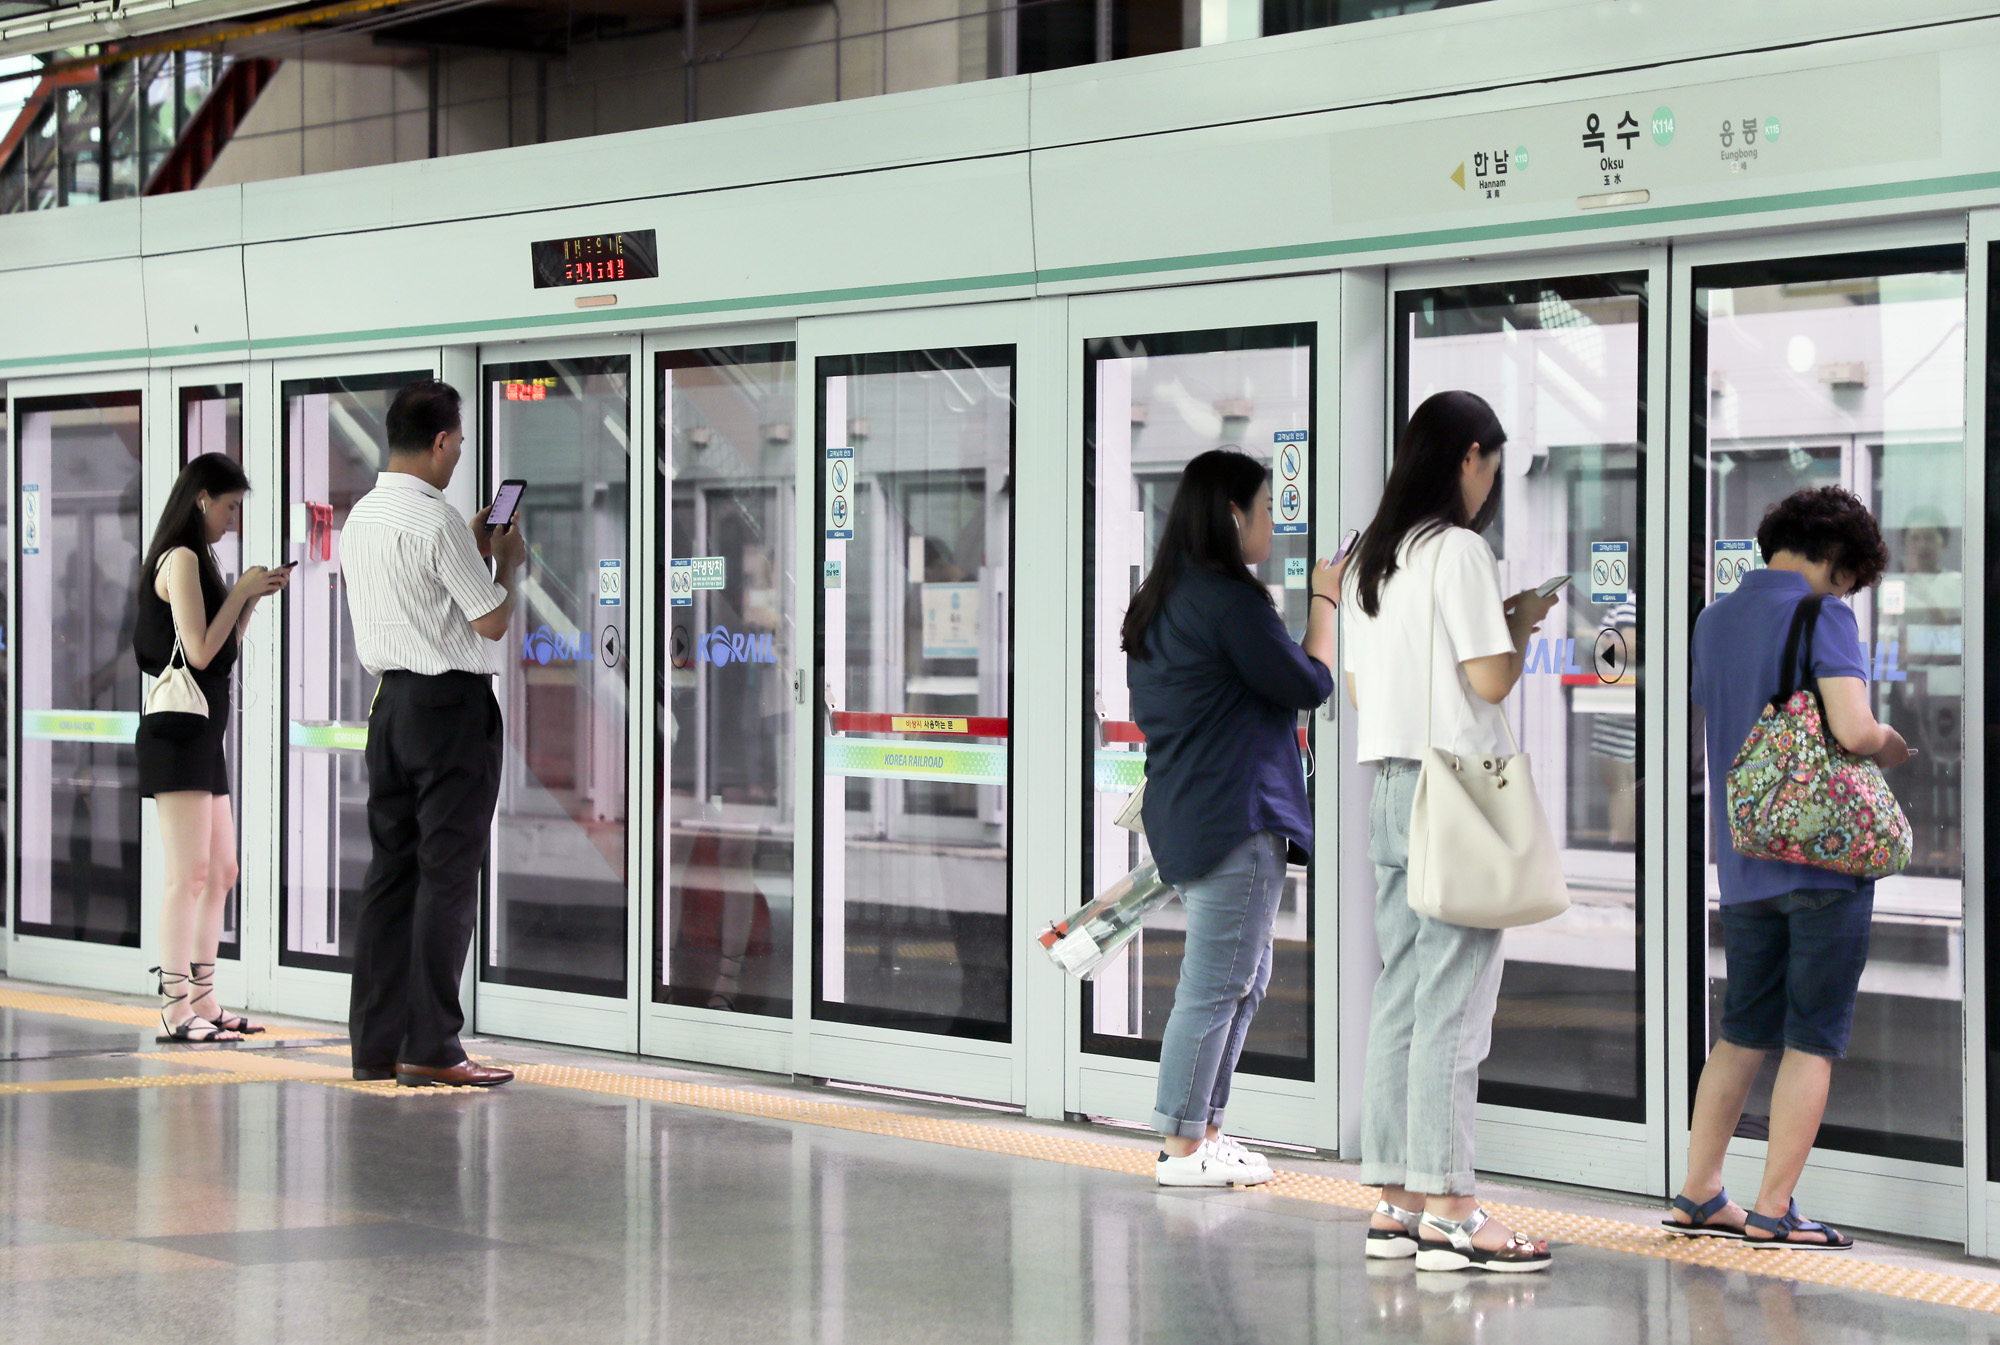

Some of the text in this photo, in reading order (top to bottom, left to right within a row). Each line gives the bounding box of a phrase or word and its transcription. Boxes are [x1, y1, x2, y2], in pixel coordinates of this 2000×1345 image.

[1582, 110, 1640, 153] 옥수
[1652, 118, 1674, 134] K114
[1719, 117, 1758, 148] 응봉
[1764, 124, 1780, 135] K115
[1720, 148, 1758, 161] Eungbong
[1473, 150, 1509, 177] 한남
[1600, 157, 1624, 171] Oksu
[1479, 179, 1506, 189] Hannam
[692, 560, 723, 576] 약냉방차
[522, 625, 595, 665] KORAIL
[697, 625, 777, 667] KORAIL
[905, 720, 953, 730] 비상시 사용하는 문
[884, 753, 944, 768] KOREA RAILROAD
